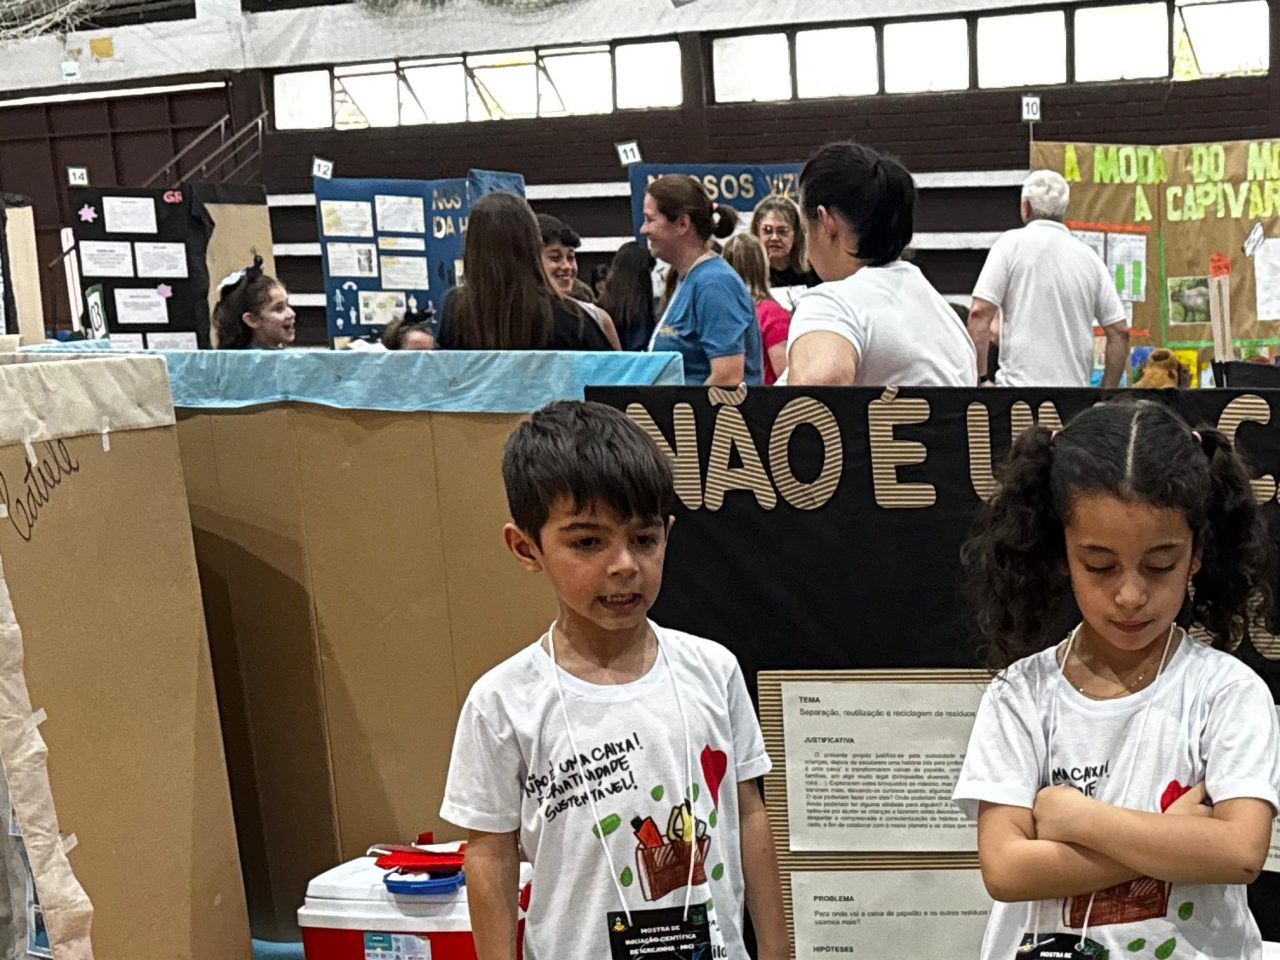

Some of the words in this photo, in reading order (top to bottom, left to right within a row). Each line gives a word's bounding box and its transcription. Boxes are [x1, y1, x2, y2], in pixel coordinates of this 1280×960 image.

[1025, 101, 1038, 115] 10
[622, 146, 636, 160] 11
[1064, 144, 1081, 182] A
[1093, 145, 1168, 184] MODA
[1192, 144, 1225, 183] DO
[71, 171, 85, 182] 14
[316, 163, 330, 176] 12
[1135, 185, 1153, 222] A
[624, 382, 844, 511] NÃO
[867, 384, 937, 509] É
[591, 731, 643, 761] CAIXA!
